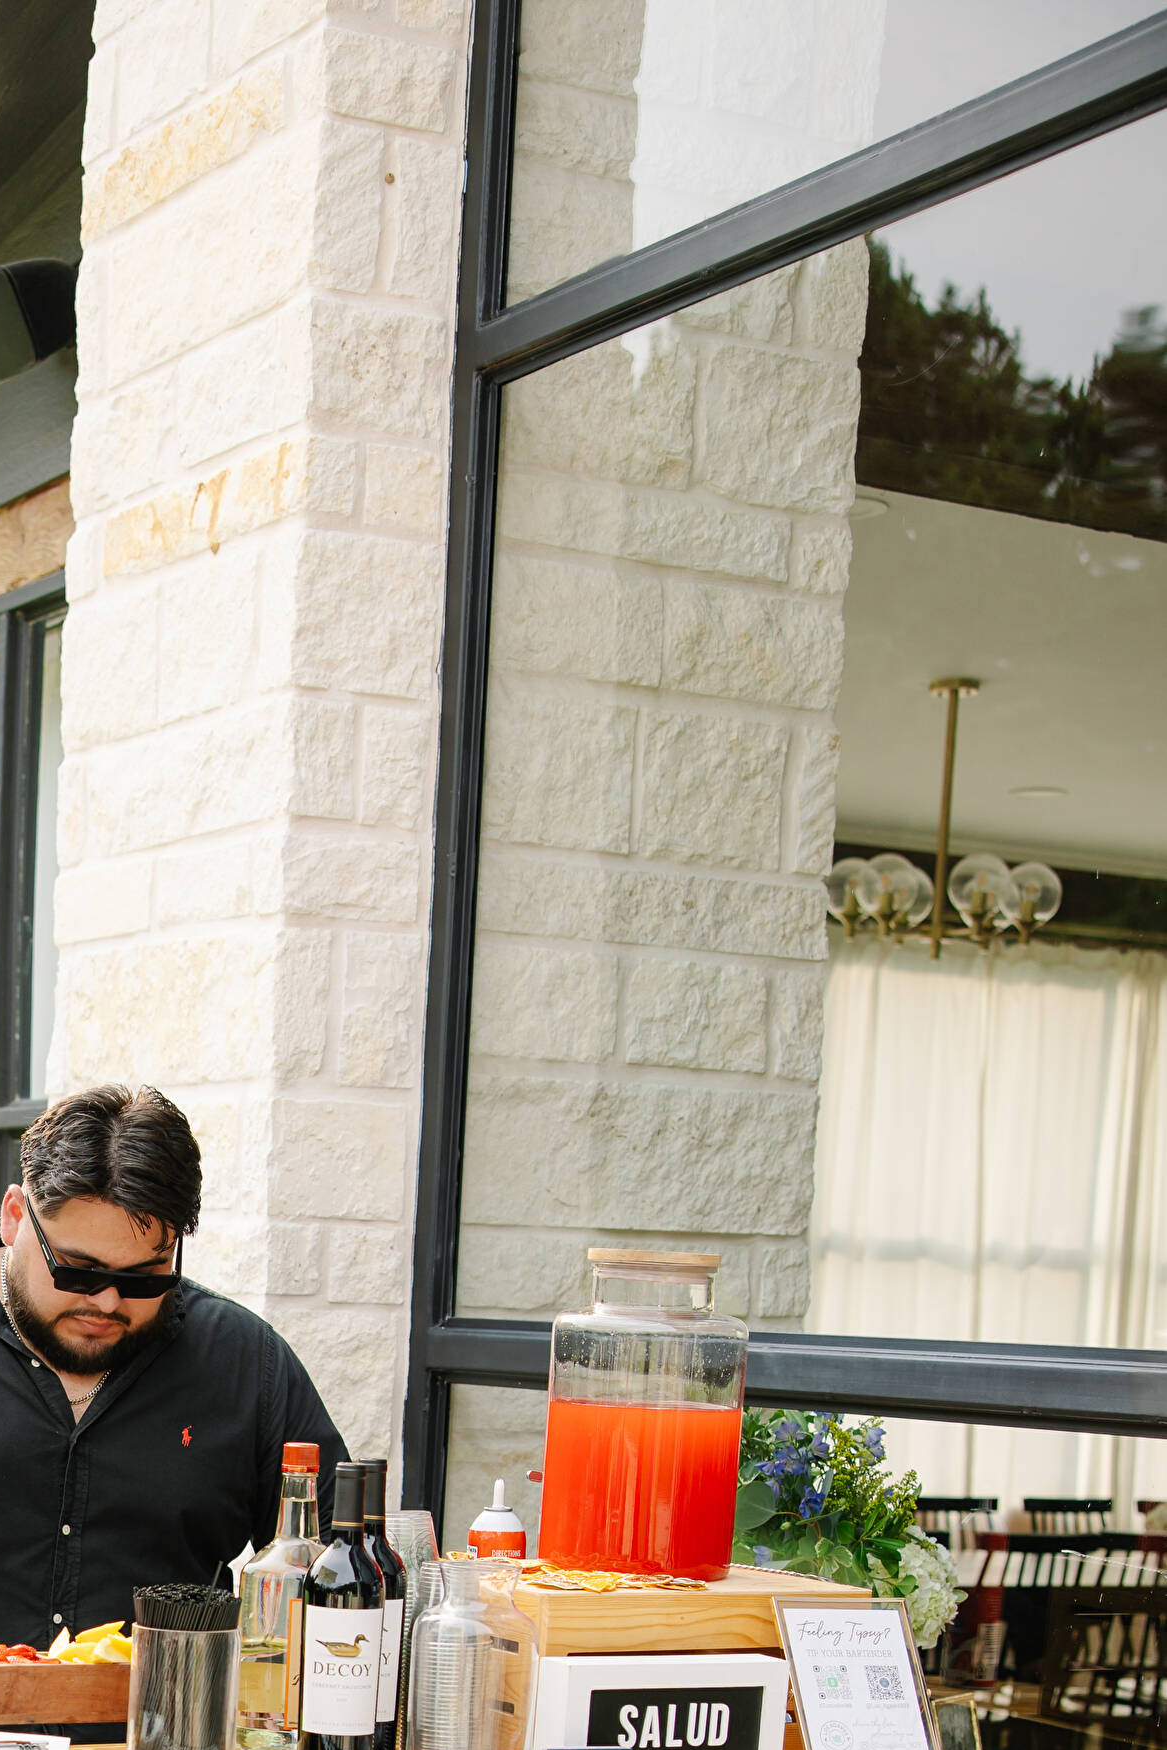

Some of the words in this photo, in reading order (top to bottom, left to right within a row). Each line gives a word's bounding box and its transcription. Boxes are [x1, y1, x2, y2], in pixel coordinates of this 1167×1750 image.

[797, 1620, 844, 1647] Feeling
[844, 1620, 891, 1646] Tipsy?
[805, 1648, 819, 1658] TIP
[820, 1648, 844, 1658] YOUR
[845, 1648, 894, 1659] BARTENDER
[313, 1660, 373, 1678] DECOY
[617, 1702, 731, 1749] SALUD
